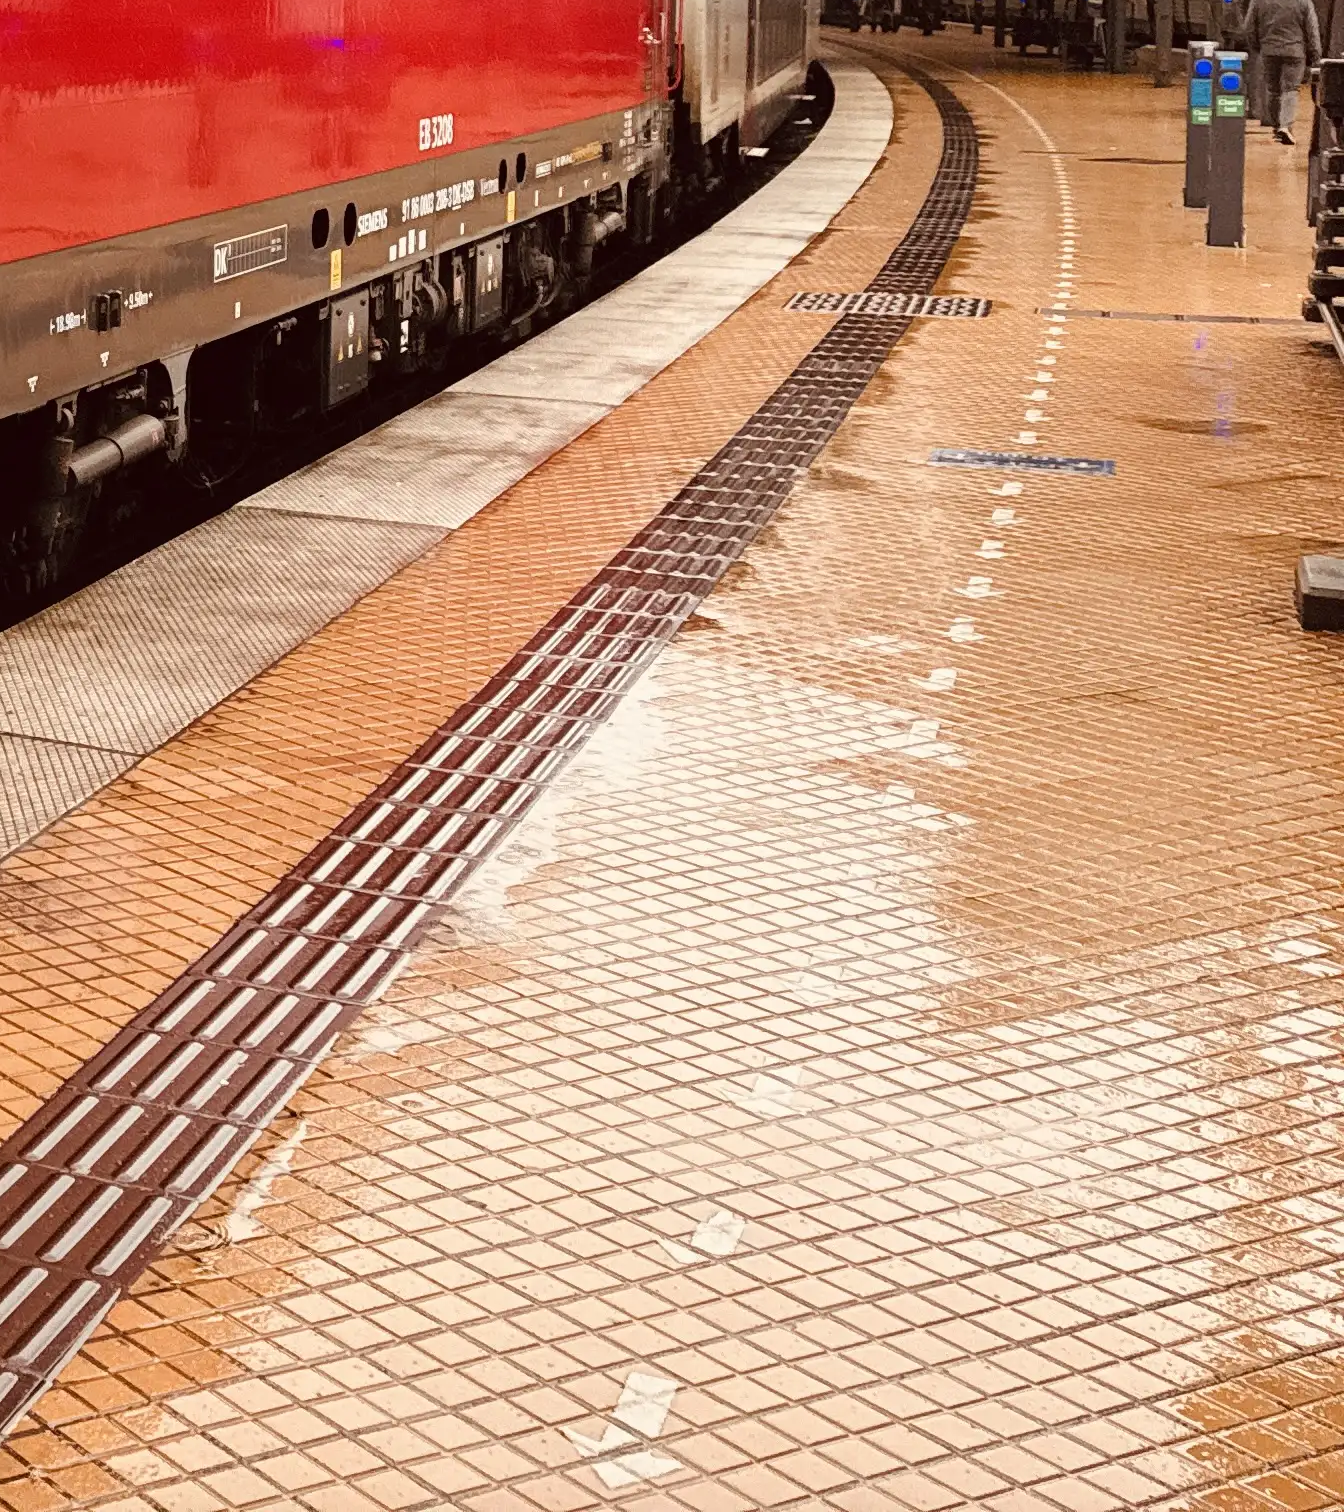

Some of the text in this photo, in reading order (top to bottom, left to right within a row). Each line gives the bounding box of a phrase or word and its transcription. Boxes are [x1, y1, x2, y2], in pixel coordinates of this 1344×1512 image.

[419, 112, 454, 152] EB 3208
[357, 207, 389, 238] SIEMENS
[214, 246, 228, 278] DK
